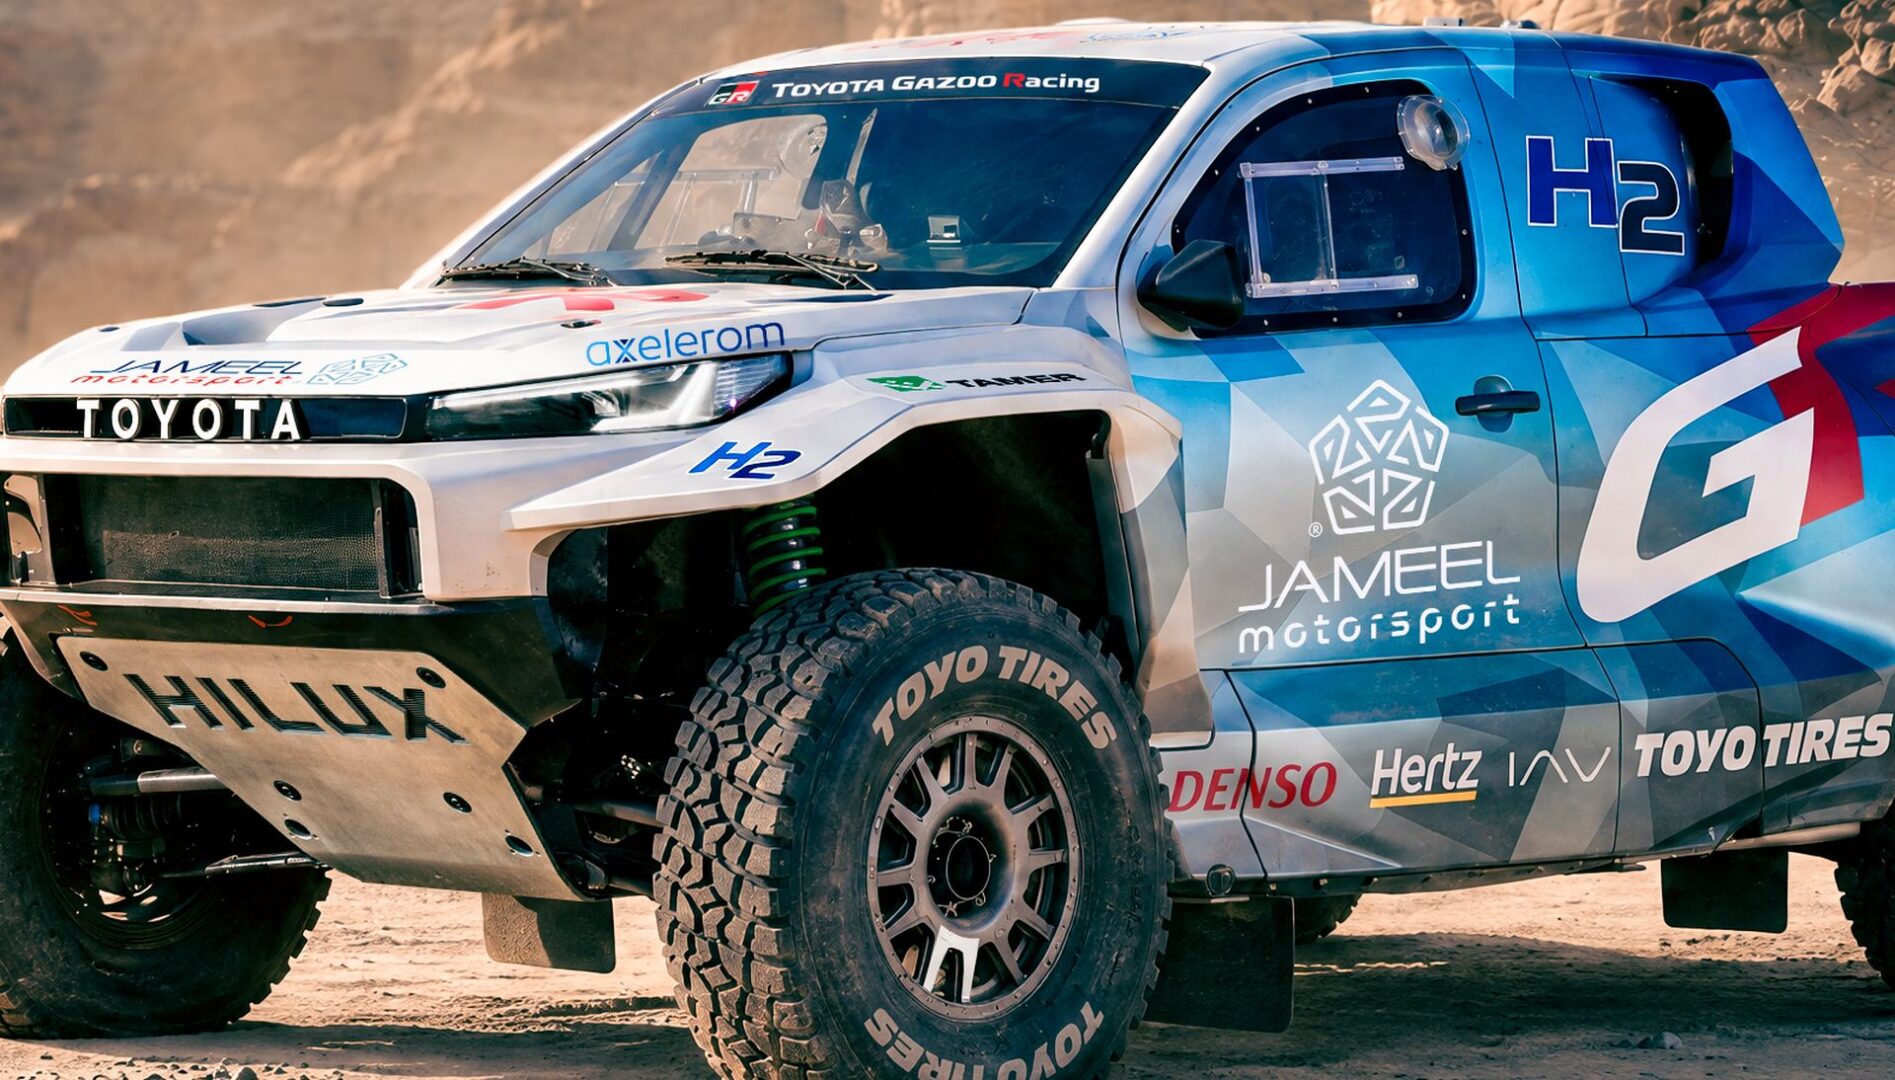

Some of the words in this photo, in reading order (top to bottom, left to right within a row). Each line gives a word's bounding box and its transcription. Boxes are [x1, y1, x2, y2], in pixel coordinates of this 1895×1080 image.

[772, 79, 885, 98] TOYOTA
[891, 75, 998, 90] GAZOO
[1002, 72, 1100, 93] Racing
[1525, 135, 1686, 256] H2
[90, 360, 303, 374] JAMEEL
[586, 322, 785, 366] axelerom
[70, 373, 293, 387] motorsport
[945, 373, 1087, 388] TAMER
[76, 398, 302, 441] TOYOTA
[688, 441, 802, 480] H2
[1238, 540, 1521, 612] JAMEEL
[1239, 594, 1520, 653] motorsport
[122, 673, 472, 744] HILUX
[871, 645, 989, 746] TOYO
[998, 645, 1118, 749] TIRES
[1371, 742, 1483, 796] Hertz
[1634, 725, 1757, 777] TOYO
[1763, 713, 1895, 768] TIRES
[1167, 762, 1337, 812] DENSO
